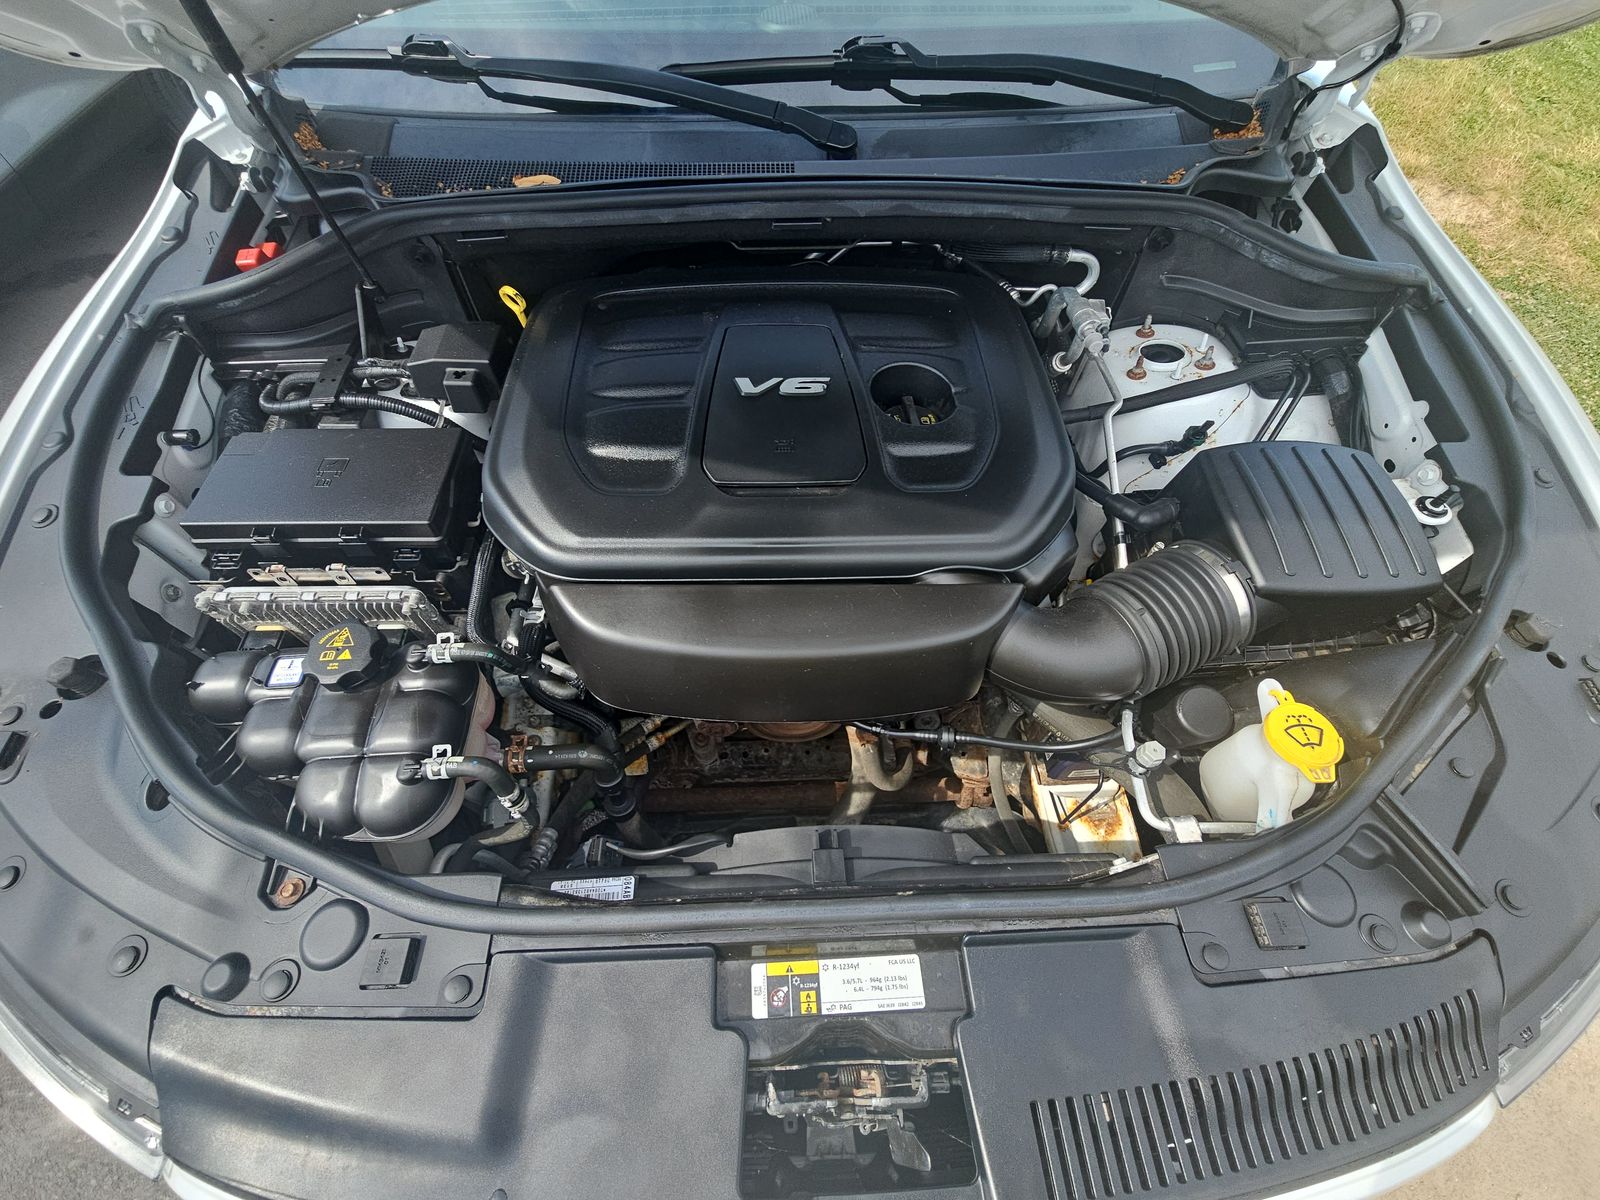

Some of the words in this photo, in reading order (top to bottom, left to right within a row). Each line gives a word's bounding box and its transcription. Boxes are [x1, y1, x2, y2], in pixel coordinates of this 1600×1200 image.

[734, 376, 831, 397] V6
[888, 958, 898, 966] FCA
[906, 957, 916, 965] LLC
[832, 962, 860, 972] R-1234yf
[842, 977, 864, 986] 3.6/5.7L
[869, 977, 882, 985] 964g
[883, 975, 897, 983] (2.13
[871, 985, 883, 993] 794g
[884, 983, 898, 992] (1.75
[839, 1003, 853, 1011] PAG
